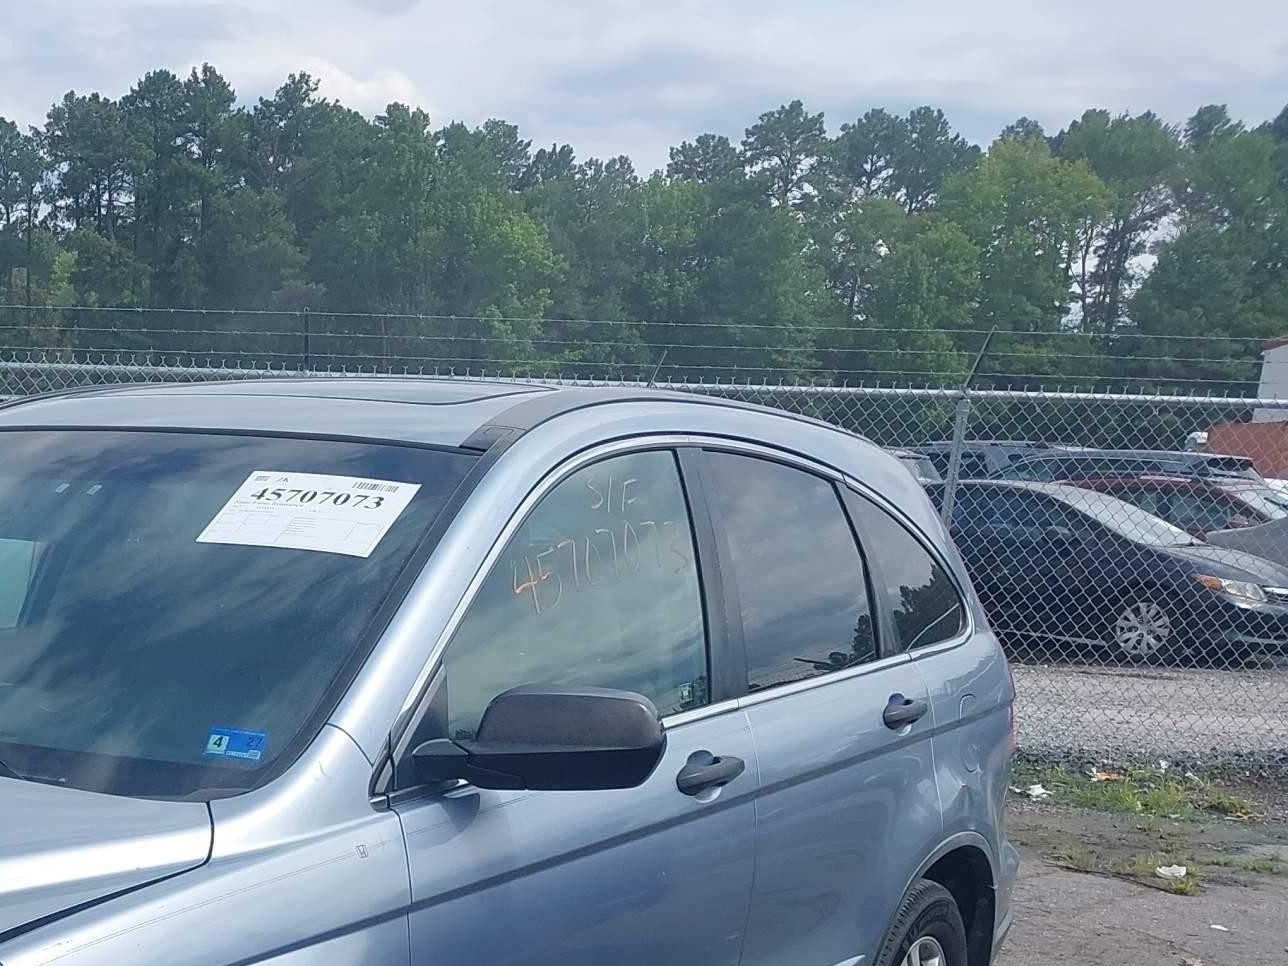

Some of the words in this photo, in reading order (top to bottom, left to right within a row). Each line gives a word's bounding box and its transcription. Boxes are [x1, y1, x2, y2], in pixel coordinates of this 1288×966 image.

[250, 486, 385, 510] 45707073
[511, 519, 690, 614] 45707073
[212, 735, 225, 748] 4
